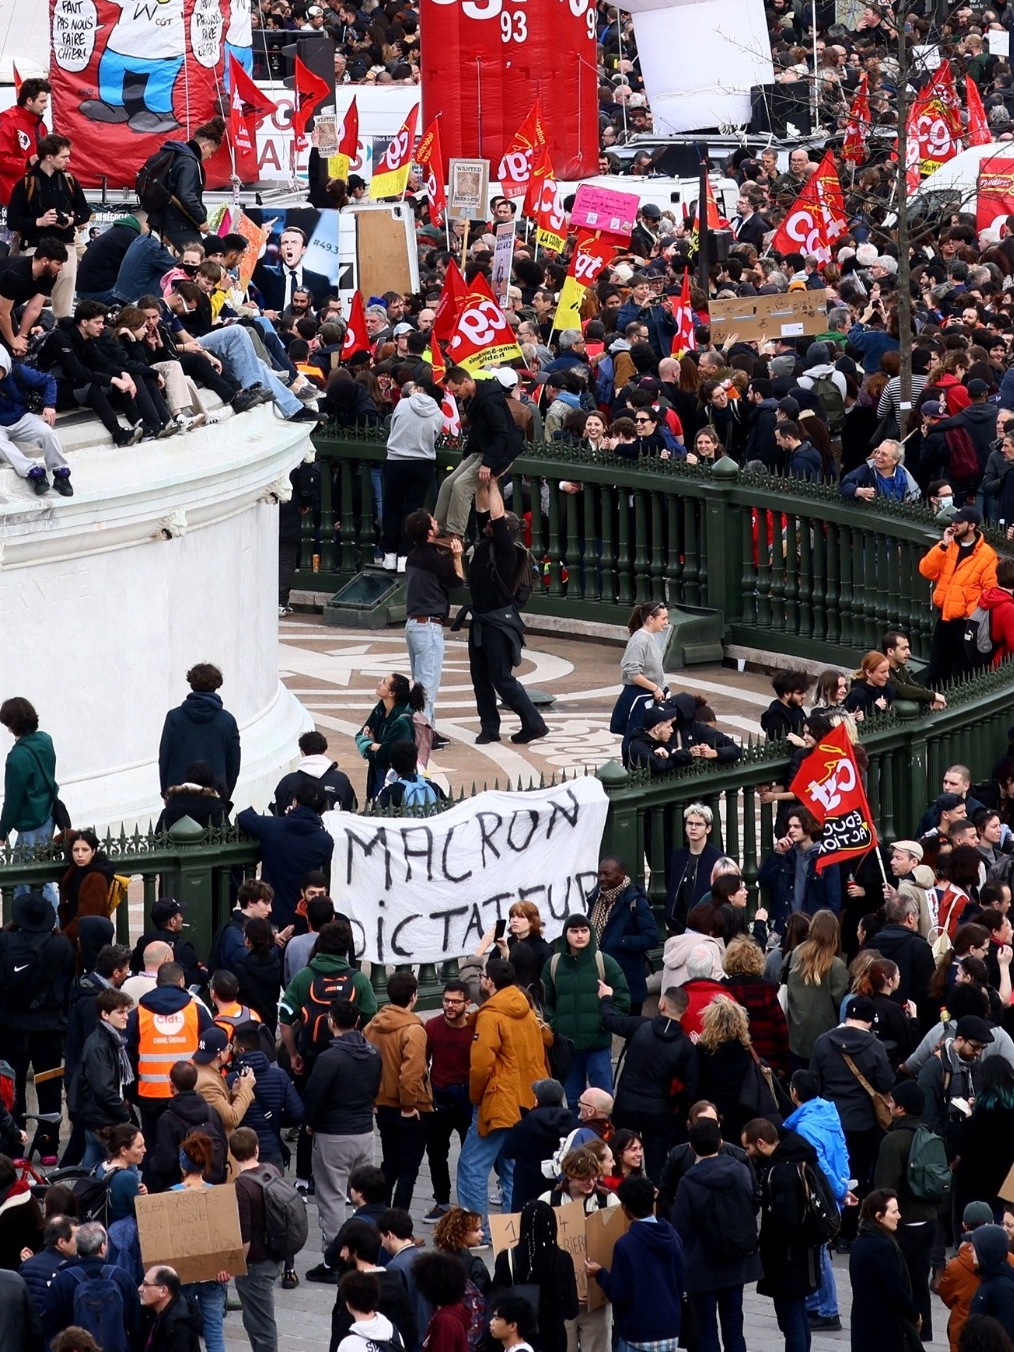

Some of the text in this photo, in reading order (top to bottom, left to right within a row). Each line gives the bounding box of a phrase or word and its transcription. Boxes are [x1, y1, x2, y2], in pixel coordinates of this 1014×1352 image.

[62, 1, 84, 14] FAUT
[57, 16, 94, 30] PAS NOUS
[155, 18, 174, 26] CGT
[500, 10, 528, 43] 93
[540, 232, 549, 244] LA
[313, 238, 339, 255] #49.3
[575, 250, 603, 279] gt
[344, 789, 580, 891] MACRON
